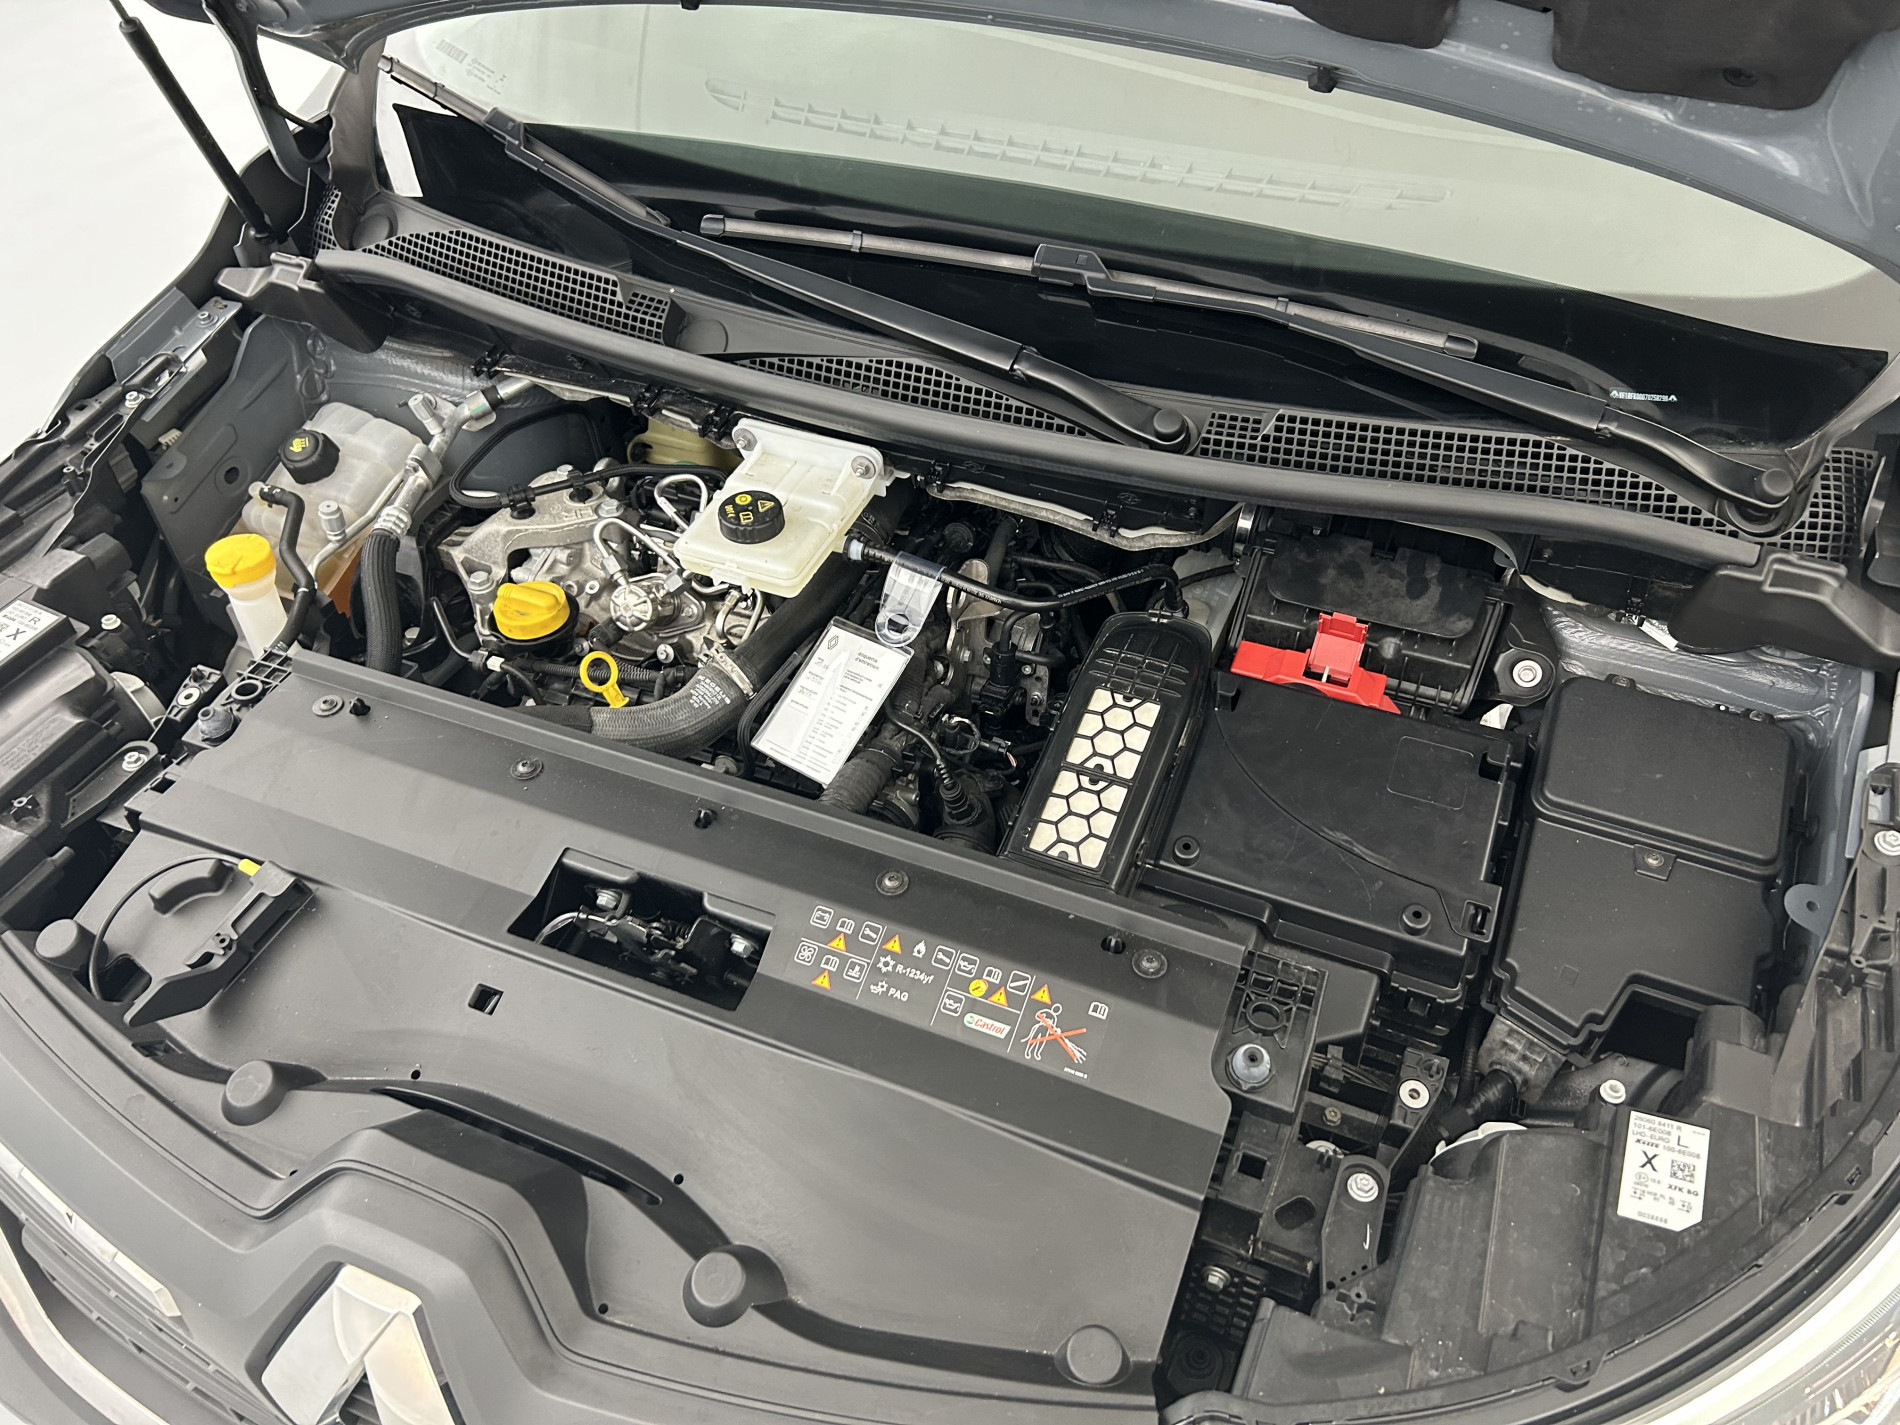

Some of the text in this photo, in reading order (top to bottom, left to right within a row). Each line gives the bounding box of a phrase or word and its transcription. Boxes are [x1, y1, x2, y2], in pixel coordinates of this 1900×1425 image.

[28, 616, 41, 625] R
[5, 627, 26, 640] X
[895, 963, 935, 984] R-1234yf
[888, 987, 909, 1002] PAG
[974, 1018, 1006, 1036] Castrol
[1677, 1135, 1689, 1149] L
[1639, 1149, 1660, 1173] X
